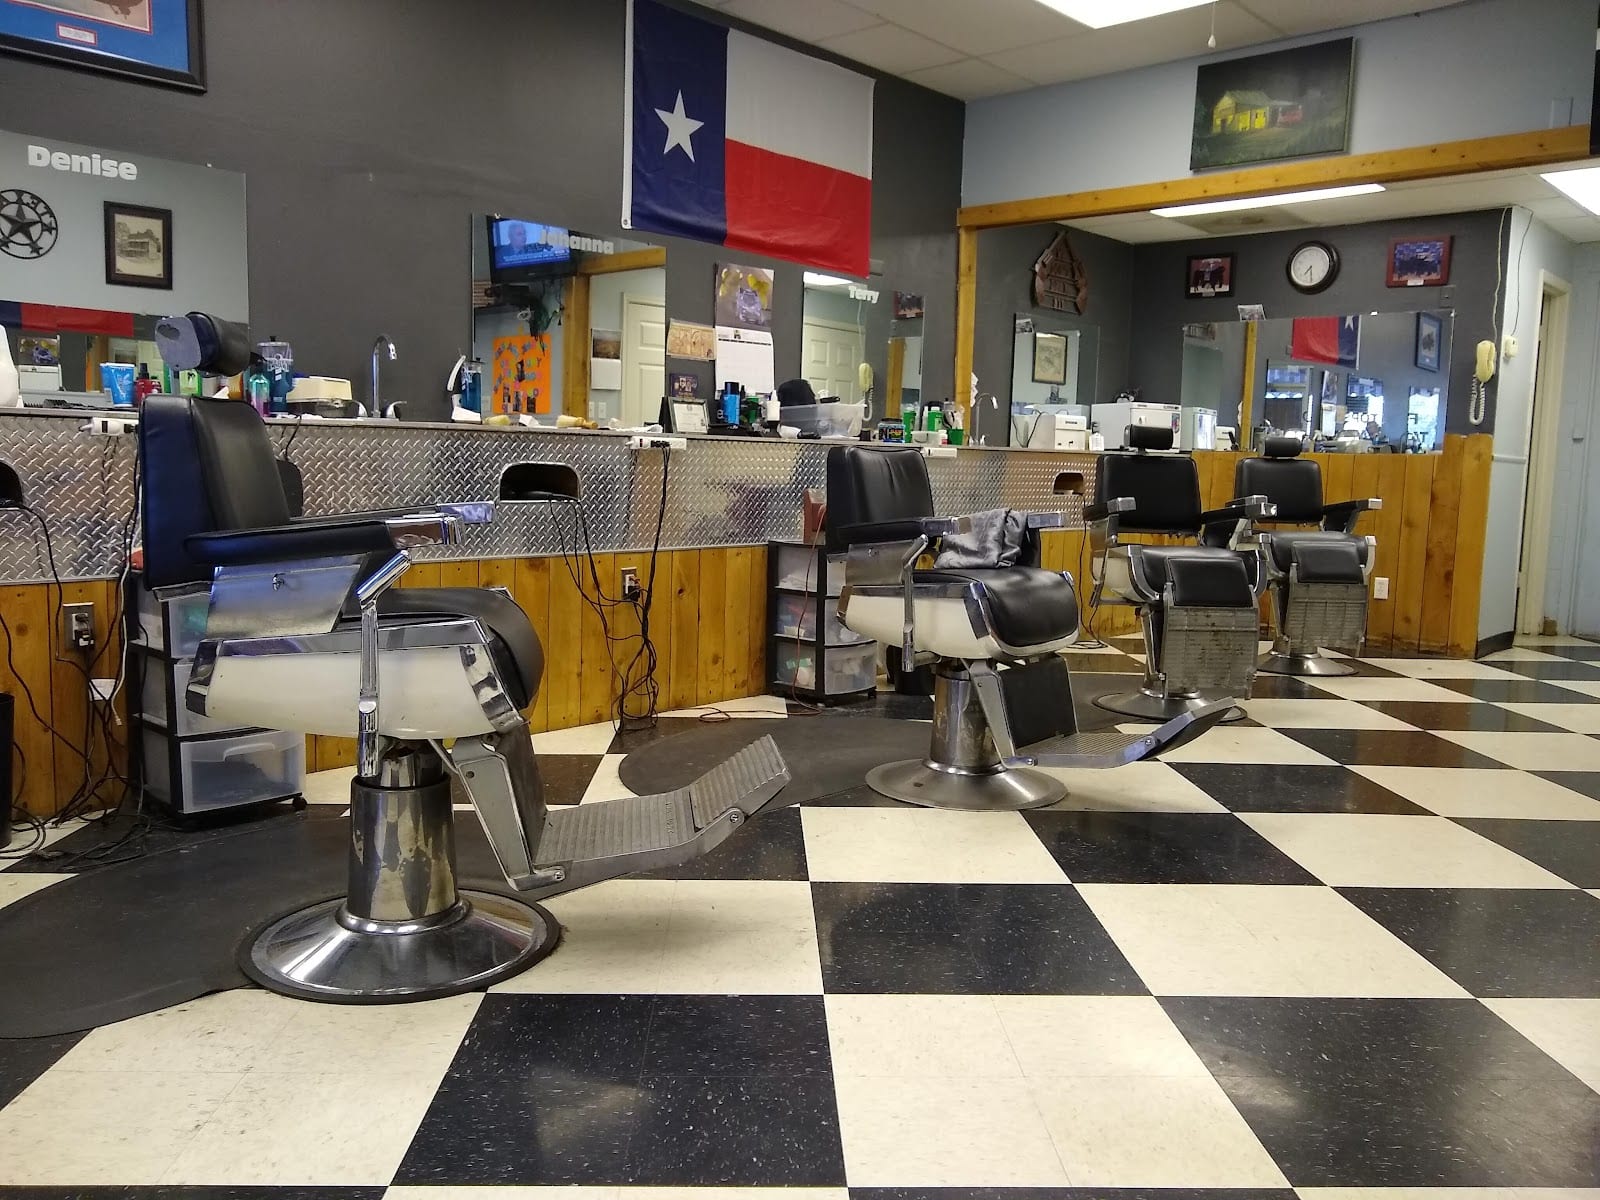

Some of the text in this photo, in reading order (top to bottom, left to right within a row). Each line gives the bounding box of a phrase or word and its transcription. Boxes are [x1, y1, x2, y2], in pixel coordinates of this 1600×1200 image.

[27, 145, 138, 180] Denise
[539, 228, 615, 255] Johanna
[848, 285, 880, 304] Terry
